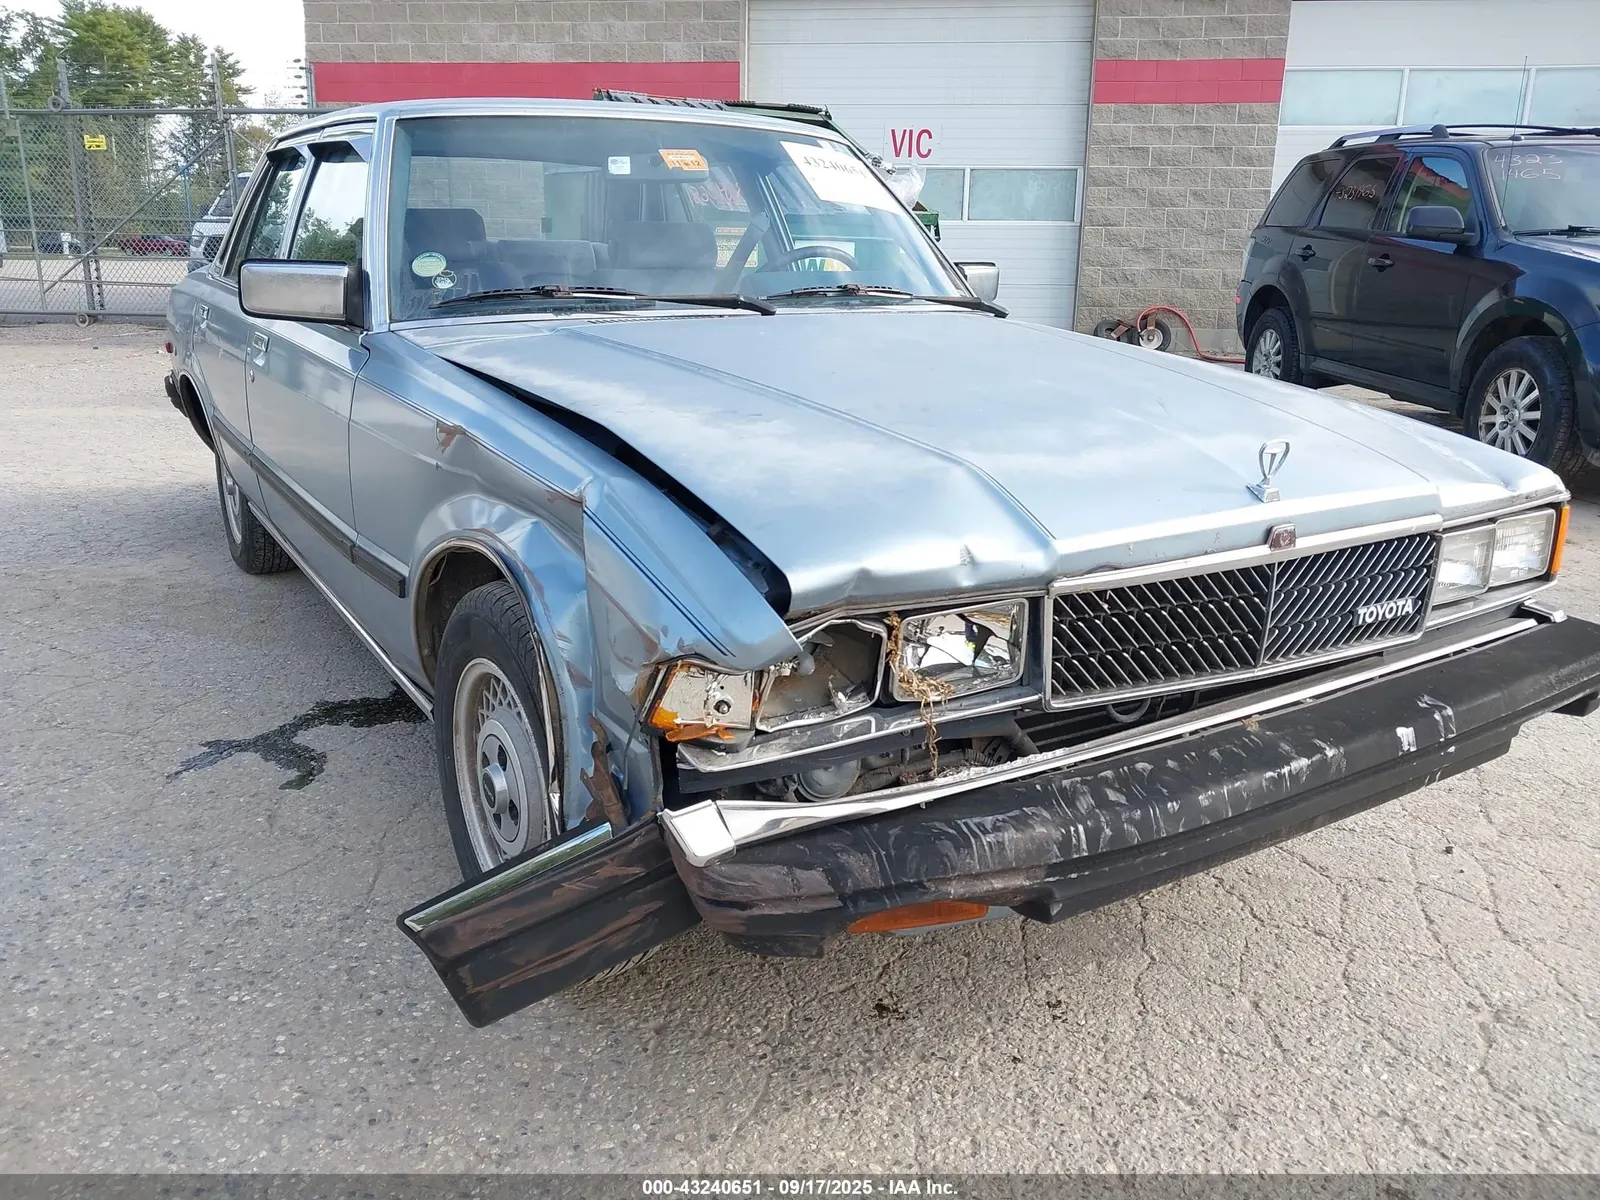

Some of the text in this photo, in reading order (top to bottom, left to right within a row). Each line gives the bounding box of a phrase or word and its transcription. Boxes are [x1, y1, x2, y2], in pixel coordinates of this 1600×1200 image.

[890, 128, 933, 159] VIC
[1494, 153, 1562, 168] 4323
[1357, 598, 1413, 625] TOYOTA
